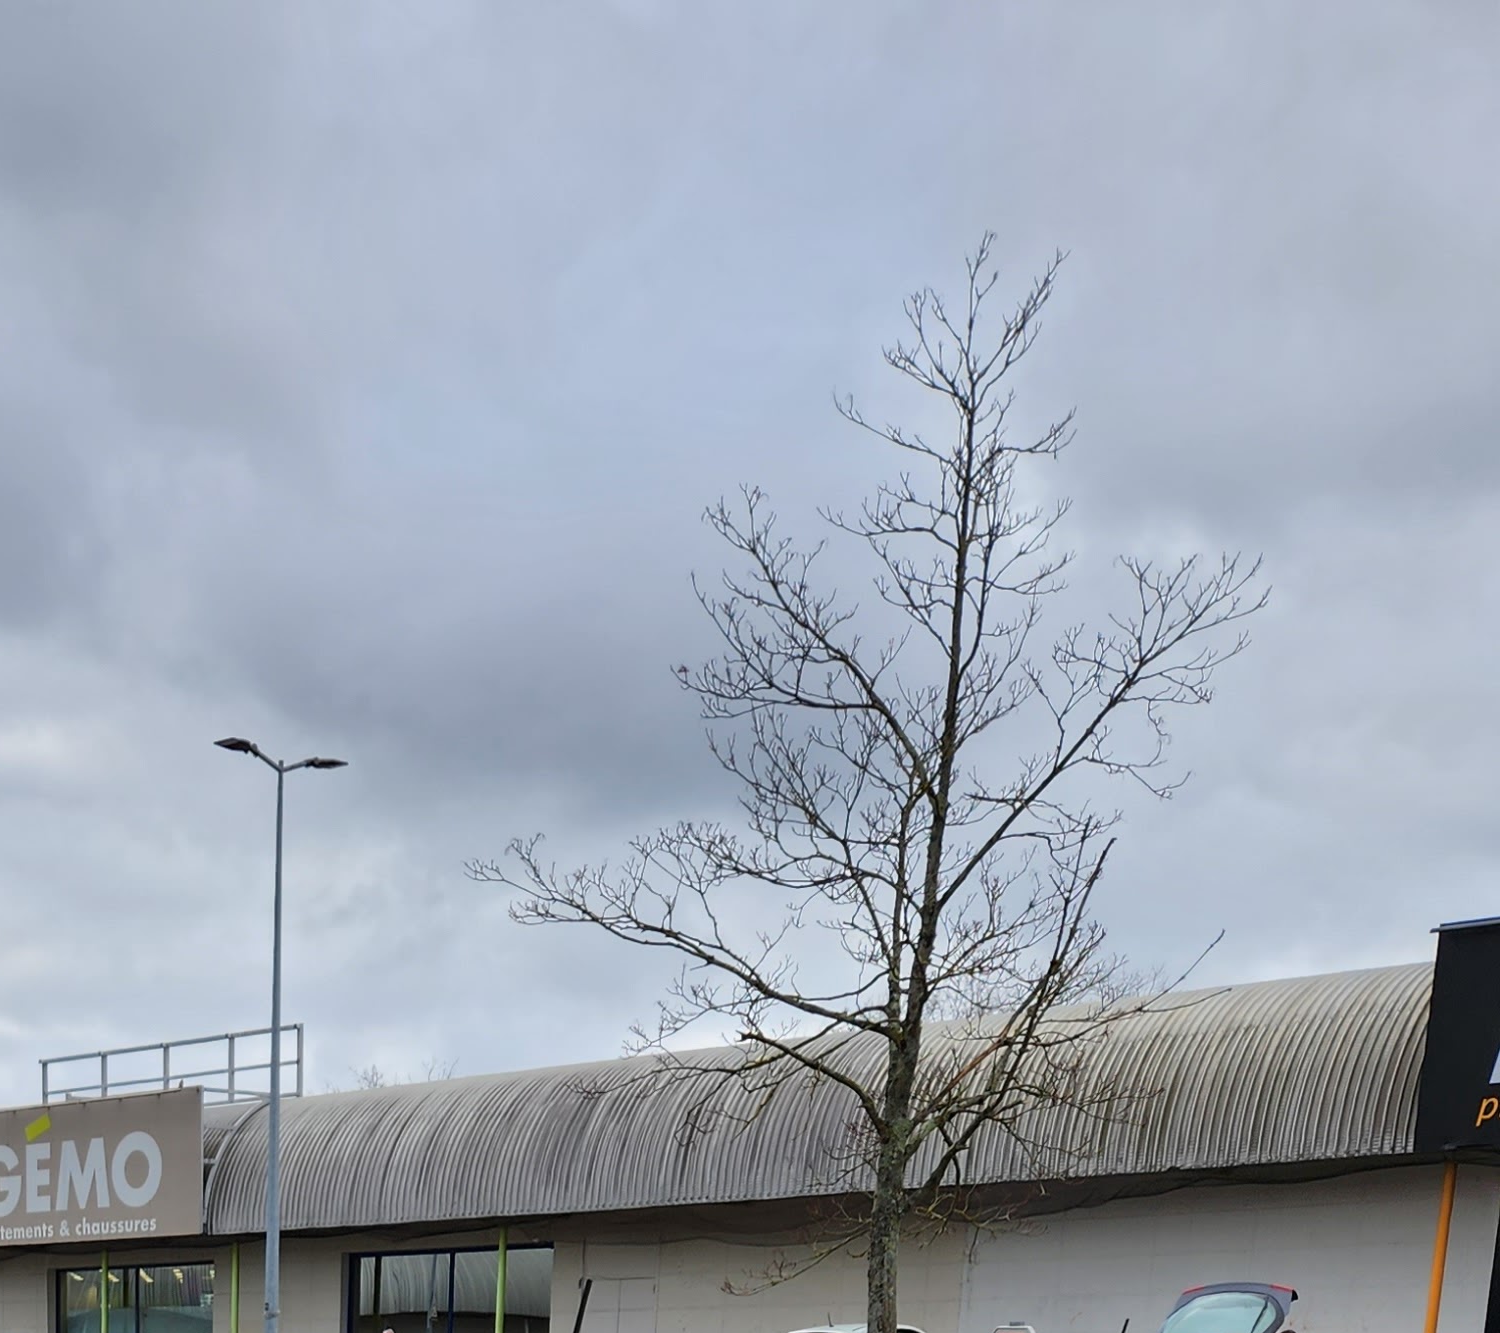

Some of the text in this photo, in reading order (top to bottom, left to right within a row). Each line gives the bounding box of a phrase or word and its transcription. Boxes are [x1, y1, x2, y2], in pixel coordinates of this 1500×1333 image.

[1475, 1097, 1500, 1127] p
[59, 1219, 70, 1237] &
[75, 1217, 157, 1236] chaussures
